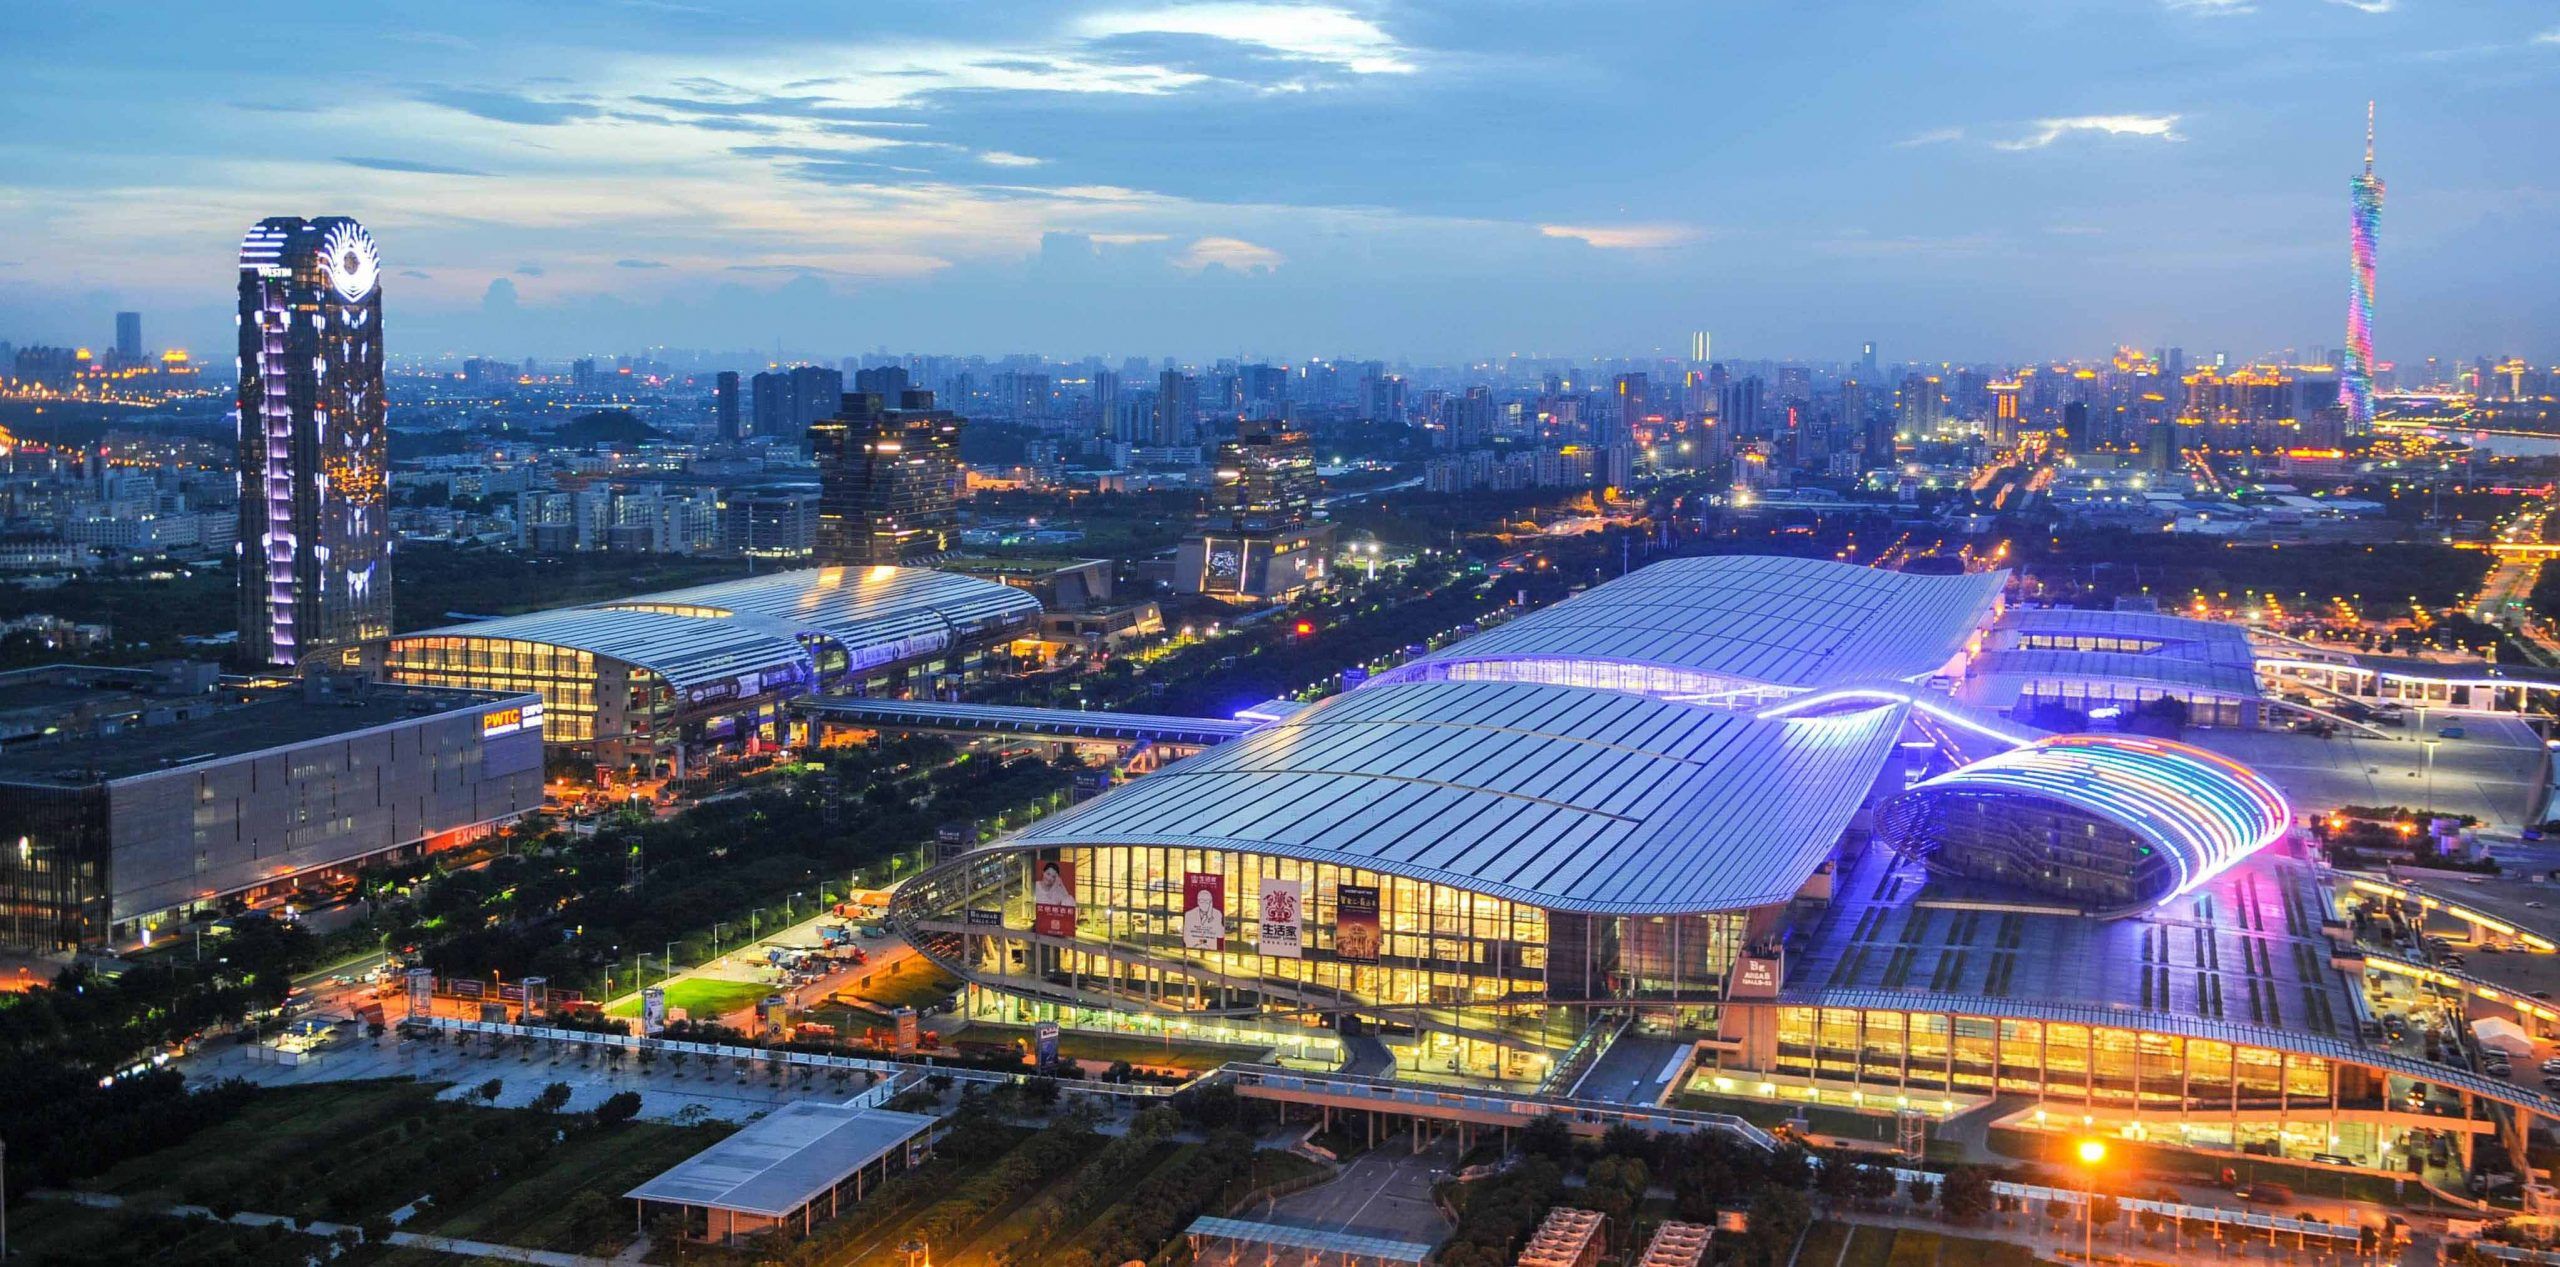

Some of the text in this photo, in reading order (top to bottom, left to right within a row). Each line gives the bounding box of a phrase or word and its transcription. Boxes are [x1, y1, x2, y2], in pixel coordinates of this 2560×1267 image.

[484, 709, 520, 729] PWTC
[1262, 924, 1297, 937] 生活家
